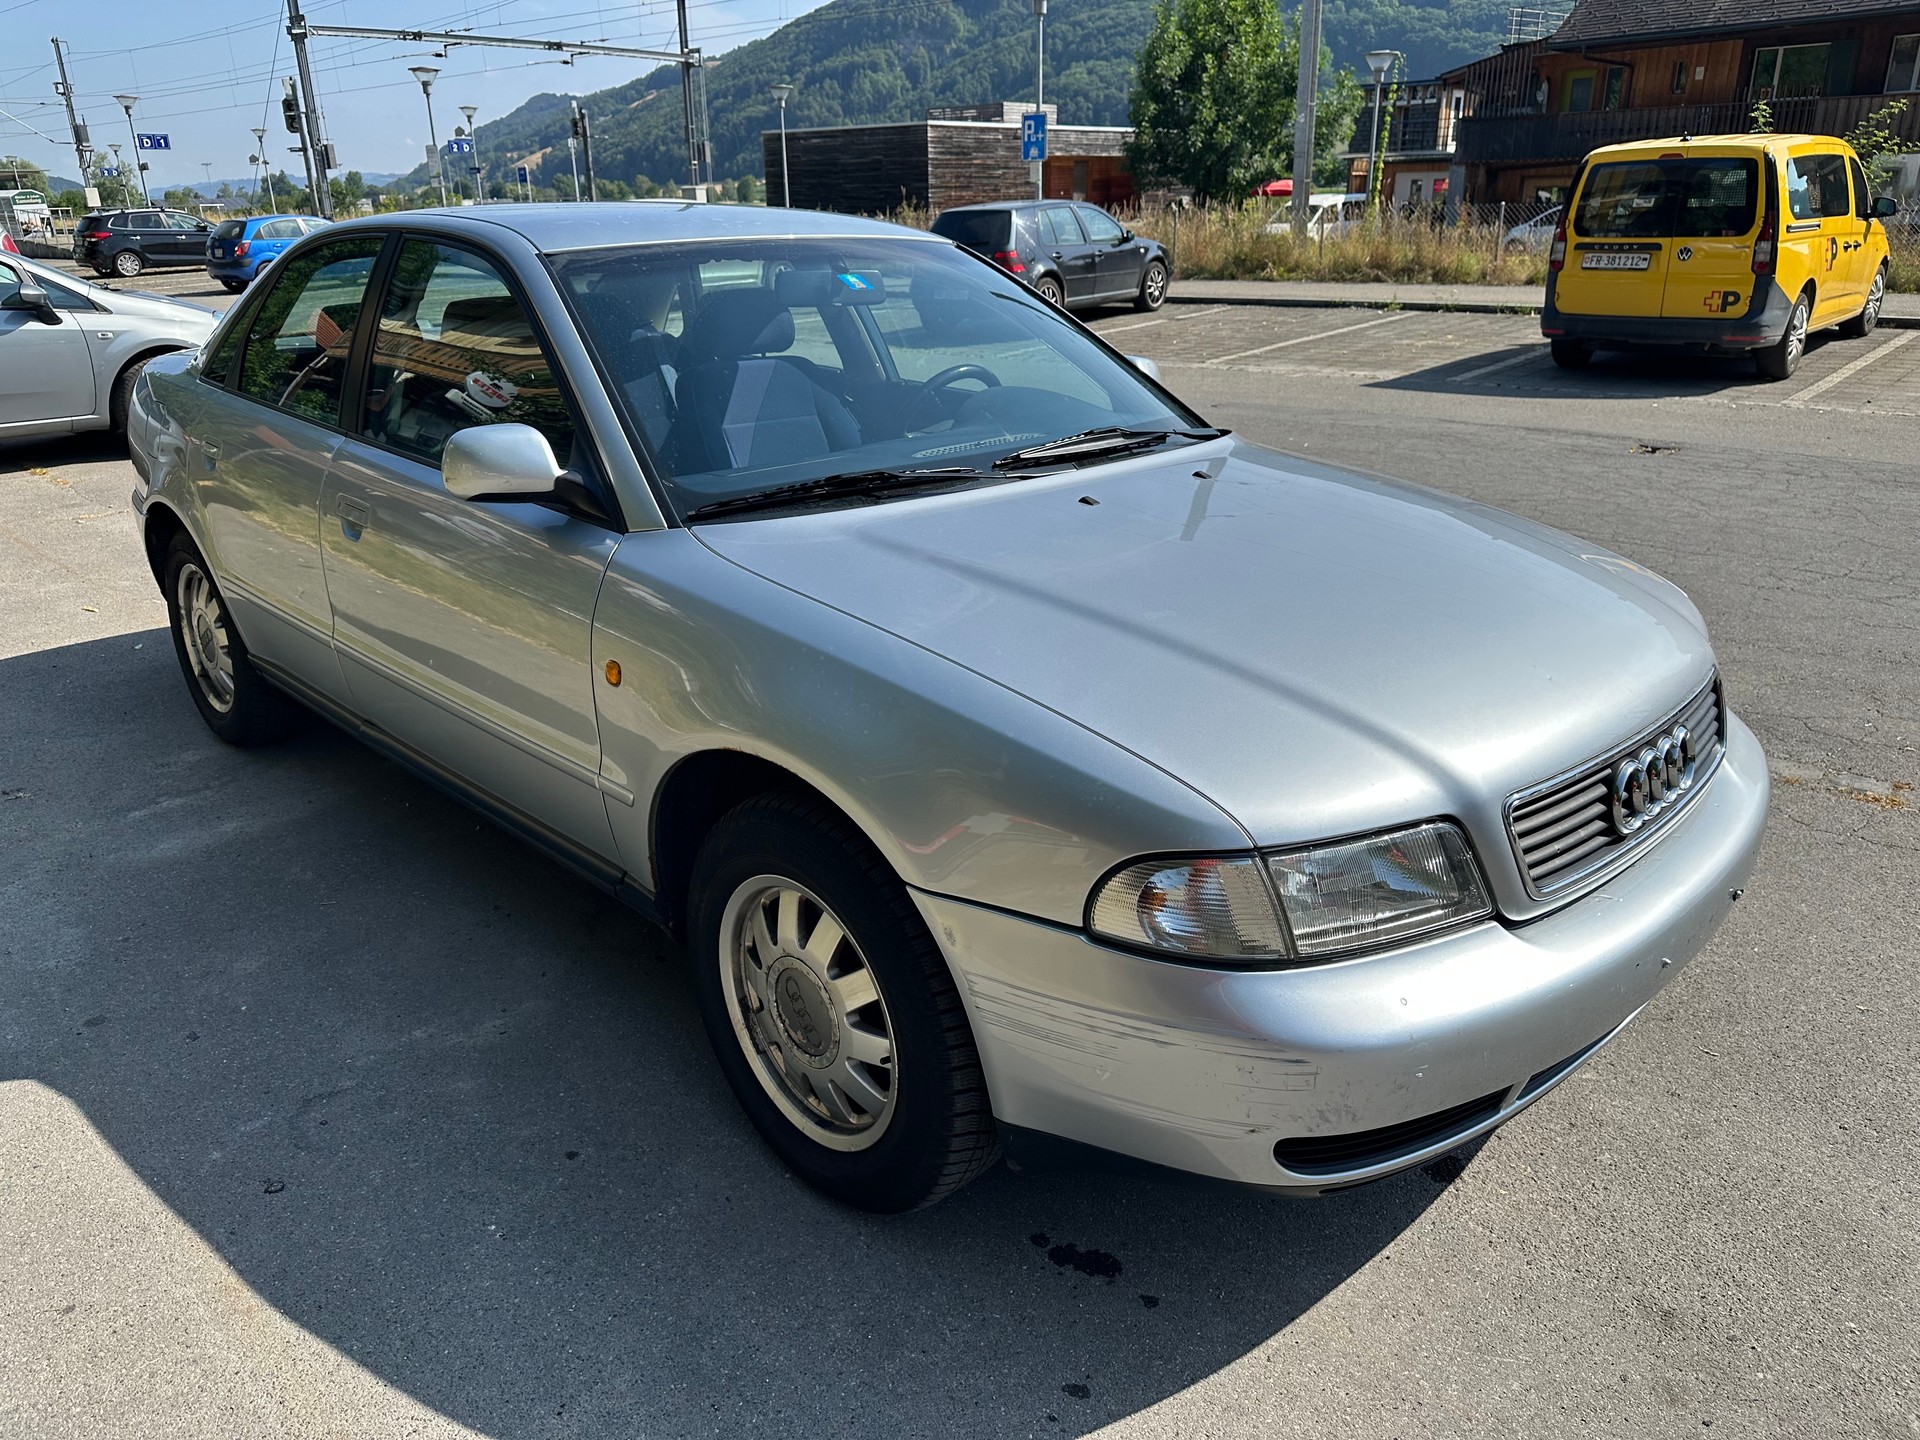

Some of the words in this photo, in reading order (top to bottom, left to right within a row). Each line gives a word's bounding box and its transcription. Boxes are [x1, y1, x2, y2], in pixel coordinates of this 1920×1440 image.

[1024, 120, 1035, 142] P
[143, 138, 151, 147] D
[159, 138, 165, 148] 1
[452, 143, 458, 152] 2
[463, 143, 470, 152] D
[1720, 290, 1741, 313] P
